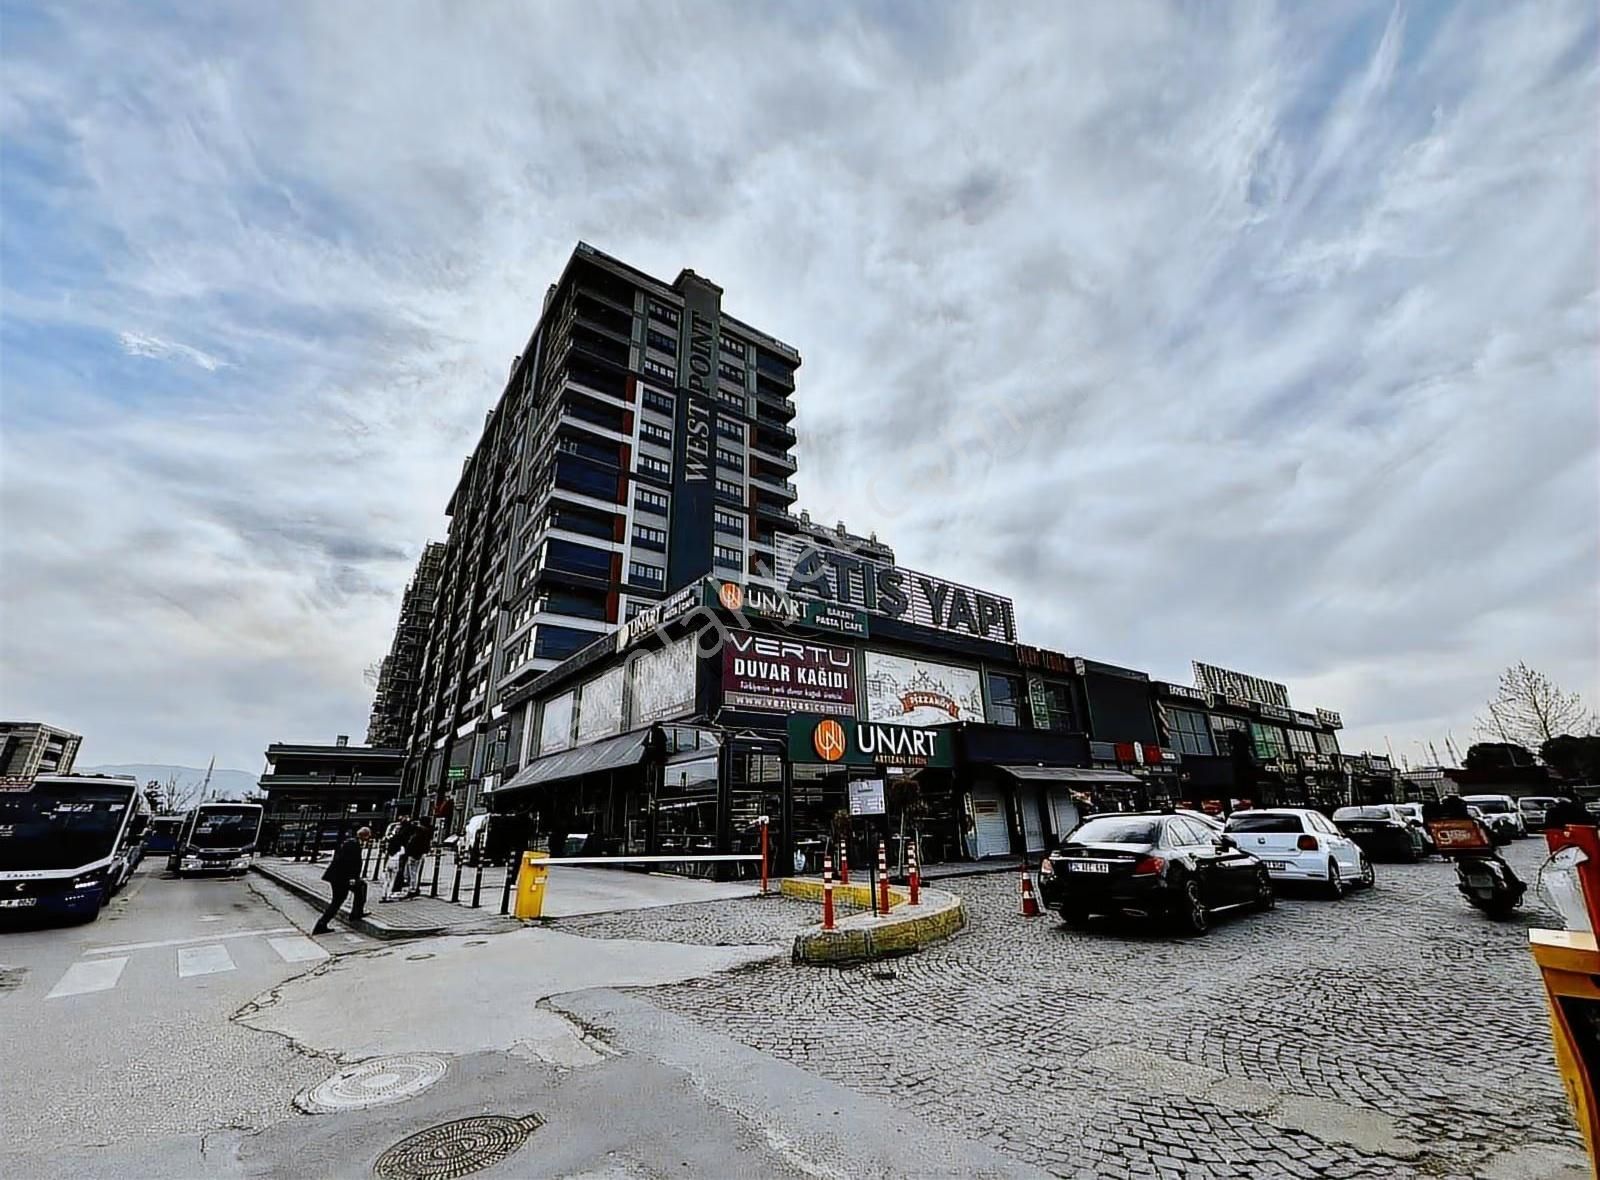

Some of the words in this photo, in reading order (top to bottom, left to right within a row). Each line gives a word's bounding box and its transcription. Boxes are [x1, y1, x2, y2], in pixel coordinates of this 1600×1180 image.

[688, 309, 714, 396] POINT
[685, 398, 710, 482] WEST
[748, 589, 810, 618] UNART
[787, 546, 908, 618] ATIŞ
[918, 577, 1014, 642] YAPI
[815, 615, 840, 628] PASTA
[844, 621, 864, 632] CAFE
[730, 632, 850, 667] VERTU
[734, 658, 790, 682] DUVAR
[797, 667, 848, 689] KAĞIDI
[858, 724, 938, 757] UNART
